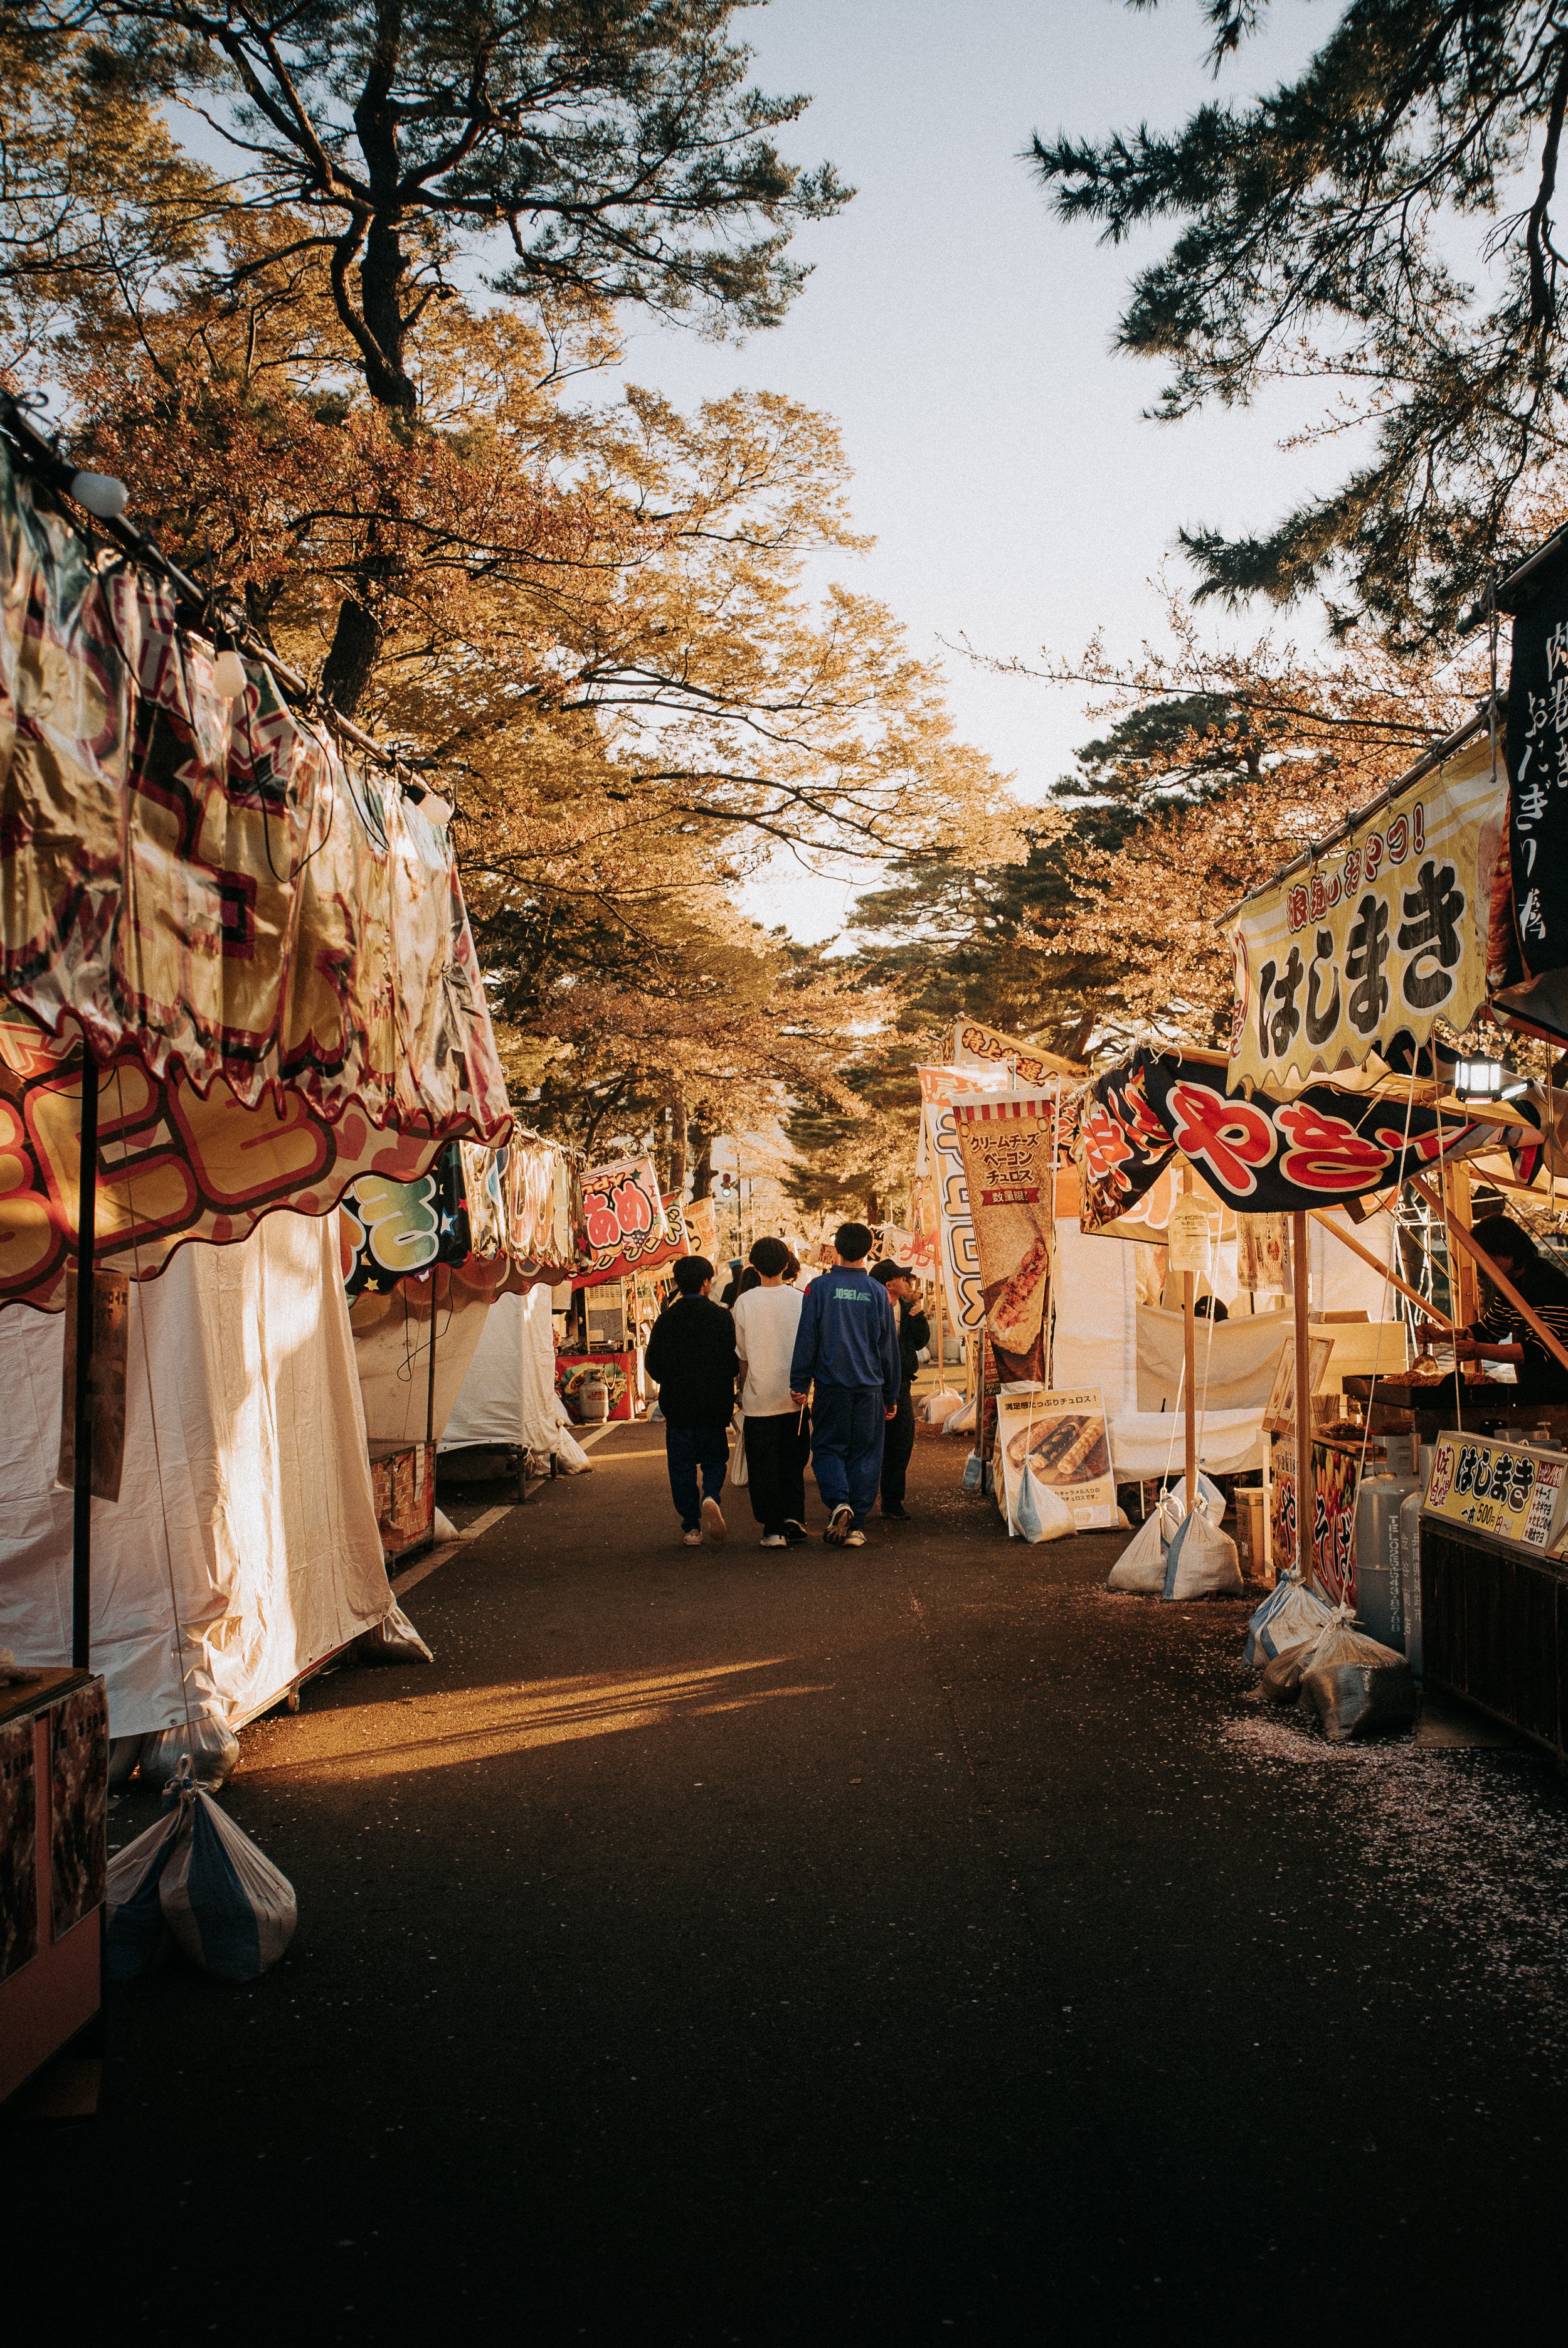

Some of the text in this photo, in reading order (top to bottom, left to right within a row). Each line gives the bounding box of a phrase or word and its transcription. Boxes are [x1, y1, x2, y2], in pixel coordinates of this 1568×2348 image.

[969, 1132, 1041, 1152] クリームチーズ
[983, 1150, 1034, 1168] ベーコン
[581, 1171, 625, 1196] ndy
[985, 1169, 1035, 1186] チュロス
[583, 1179, 653, 1248] あめ
[833, 1287, 857, 1300] JOSEI
